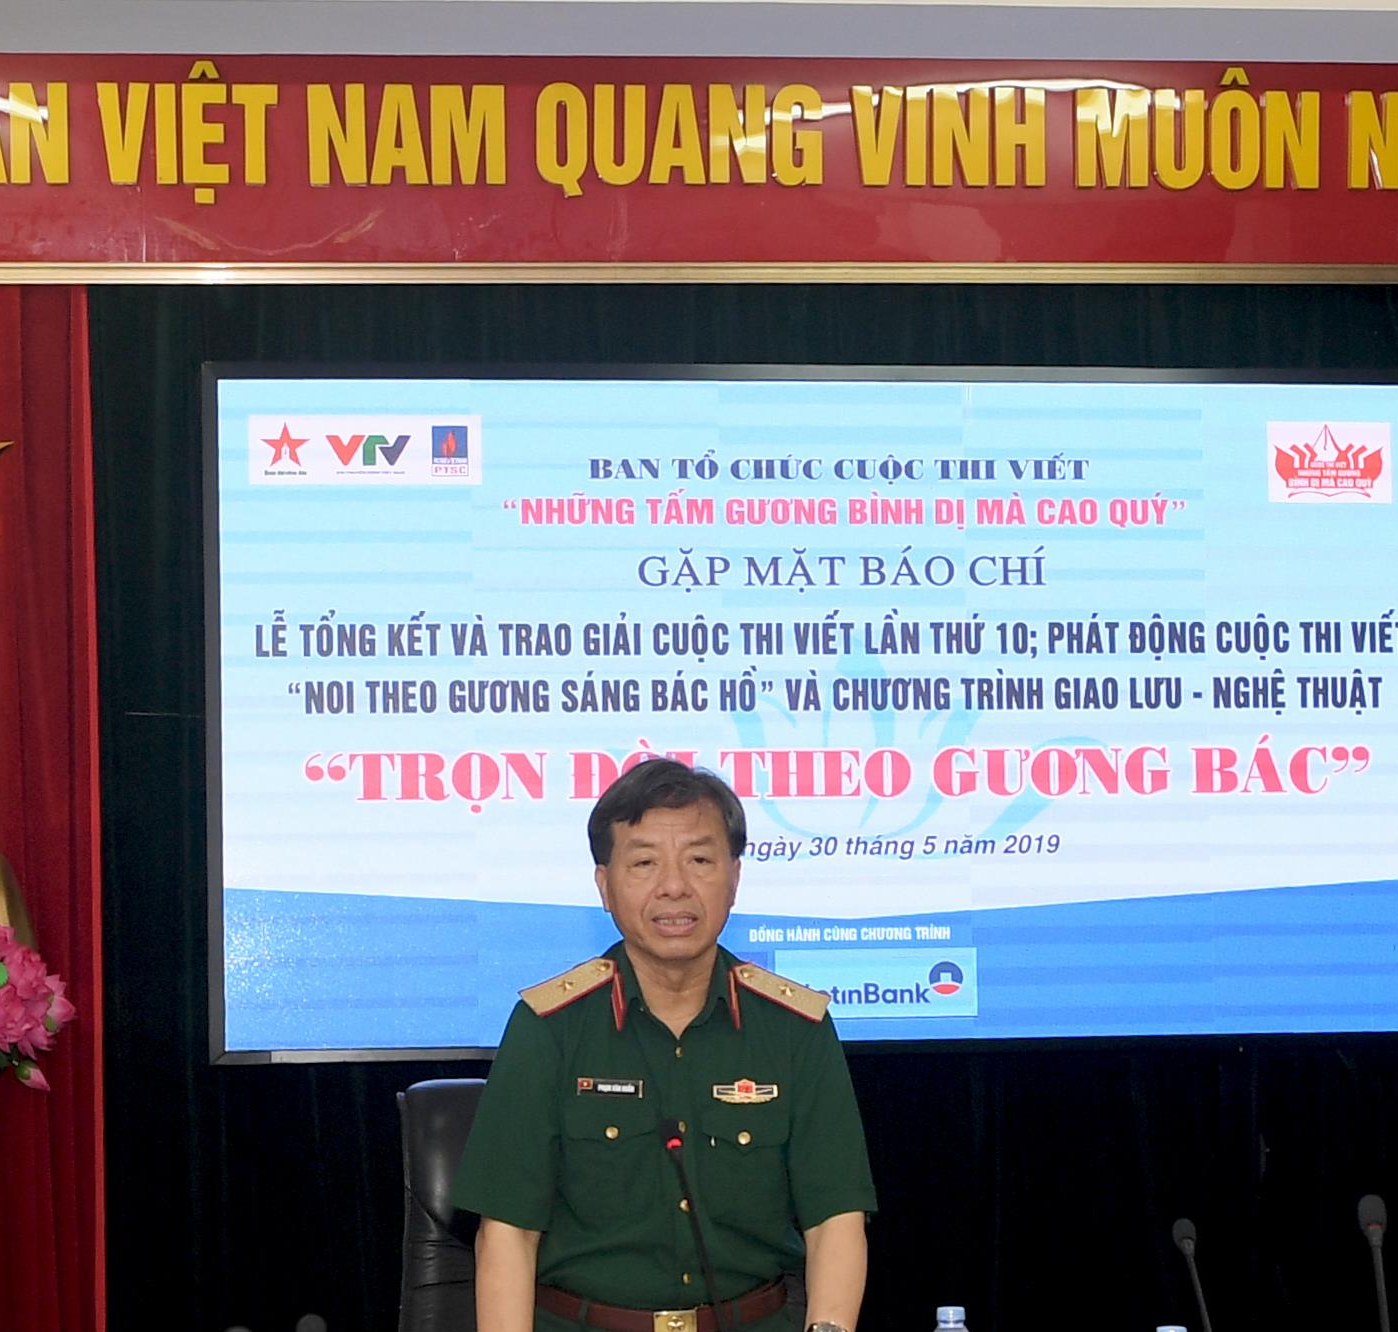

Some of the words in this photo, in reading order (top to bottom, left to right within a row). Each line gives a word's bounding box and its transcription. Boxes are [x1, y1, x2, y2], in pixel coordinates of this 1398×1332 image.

[97, 61, 277, 203] VIỆT
[308, 82, 506, 186] NAM
[535, 82, 823, 197] QUANG
[850, 84, 1046, 188] VINH
[1076, 67, 1318, 190] MUÔN
[325, 435, 411, 466] VTV
[591, 459, 658, 478] BAN
[672, 450, 718, 479] TỔ
[731, 455, 821, 479] CHỨC
[834, 455, 923, 484] CUỘC
[935, 460, 994, 479] THI
[1009, 453, 1088, 479] VIẾT
[647, 490, 715, 526] TẤM
[725, 497, 838, 526] GƯƠNG
[847, 490, 924, 526] BÌNH
[934, 498, 966, 531] DỊ
[975, 491, 1027, 526] MÀ
[1037, 497, 1098, 526] CAO
[639, 548, 730, 592] GẶP
[745, 548, 845, 592] MẶT
[861, 546, 954, 586] BÁO
[970, 546, 1045, 585] CHÍ
[256, 610, 287, 657] LỄ
[300, 610, 375, 657] TỔNG
[388, 611, 440, 656] KẾT
[451, 615, 487, 656] VÀ
[499, 624, 571, 655] TRAO
[584, 612, 641, 655] GIẢI
[653, 615, 728, 662] CUỘC
[740, 623, 782, 654] THI
[794, 610, 854, 654] VIẾT
[865, 609, 919, 654] LẦN
[930, 613, 985, 654] THỨ
[997, 623, 1037, 658] 10;
[1049, 613, 1119, 653] PHÁT
[1129, 613, 1205, 660] ĐỘNG
[1217, 613, 1289, 660] CUỘC
[1299, 622, 1341, 653] THI
[366, 681, 436, 713] THEO
[449, 680, 549, 713] GƯƠNG
[562, 671, 639, 712] SÁNG
[652, 670, 707, 711] BÁC
[786, 670, 821, 710] VÀ
[833, 678, 950, 711] CHƯƠNG
[961, 669, 1043, 710] TRÌNH
[1055, 677, 1118, 709] GIAO
[1130, 677, 1181, 709] LƯU
[1213, 669, 1285, 715] NGHỆ
[1297, 669, 1382, 715] THUẬT
[720, 750, 911, 797] THEO
[933, 747, 1168, 796] GƯƠNG
[744, 836, 801, 861] ngày
[810, 837, 837, 856] 30
[847, 835, 914, 859] tháng
[923, 836, 936, 854] 5
[945, 836, 995, 854] năm
[1004, 835, 1059, 853] 2019
